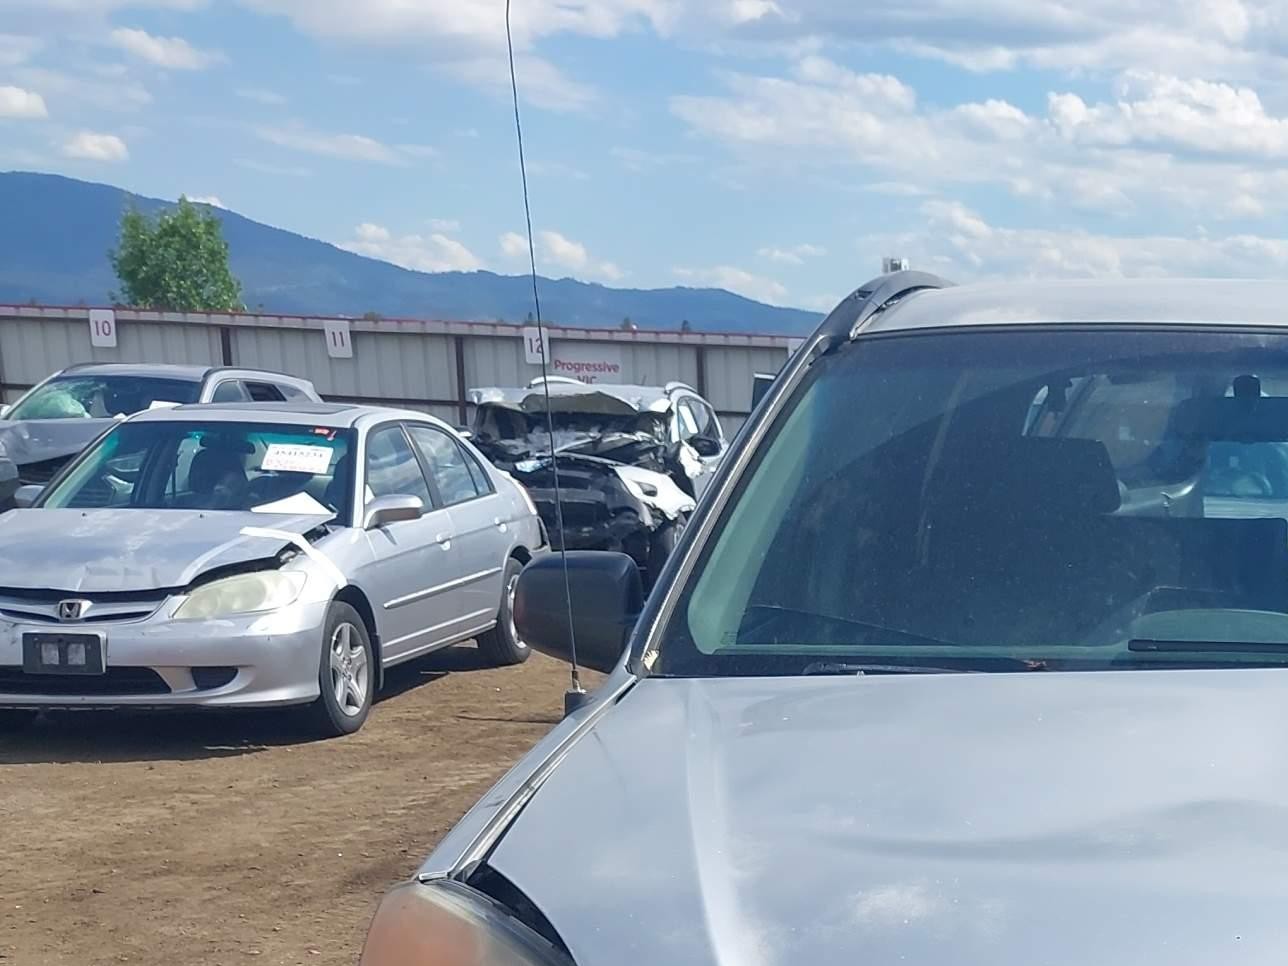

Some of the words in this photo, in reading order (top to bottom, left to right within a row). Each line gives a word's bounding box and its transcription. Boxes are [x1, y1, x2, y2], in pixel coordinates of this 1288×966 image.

[95, 320, 111, 336] 10
[332, 331, 345, 347] 11
[529, 337, 544, 354] 12
[554, 360, 620, 373] Progressive
